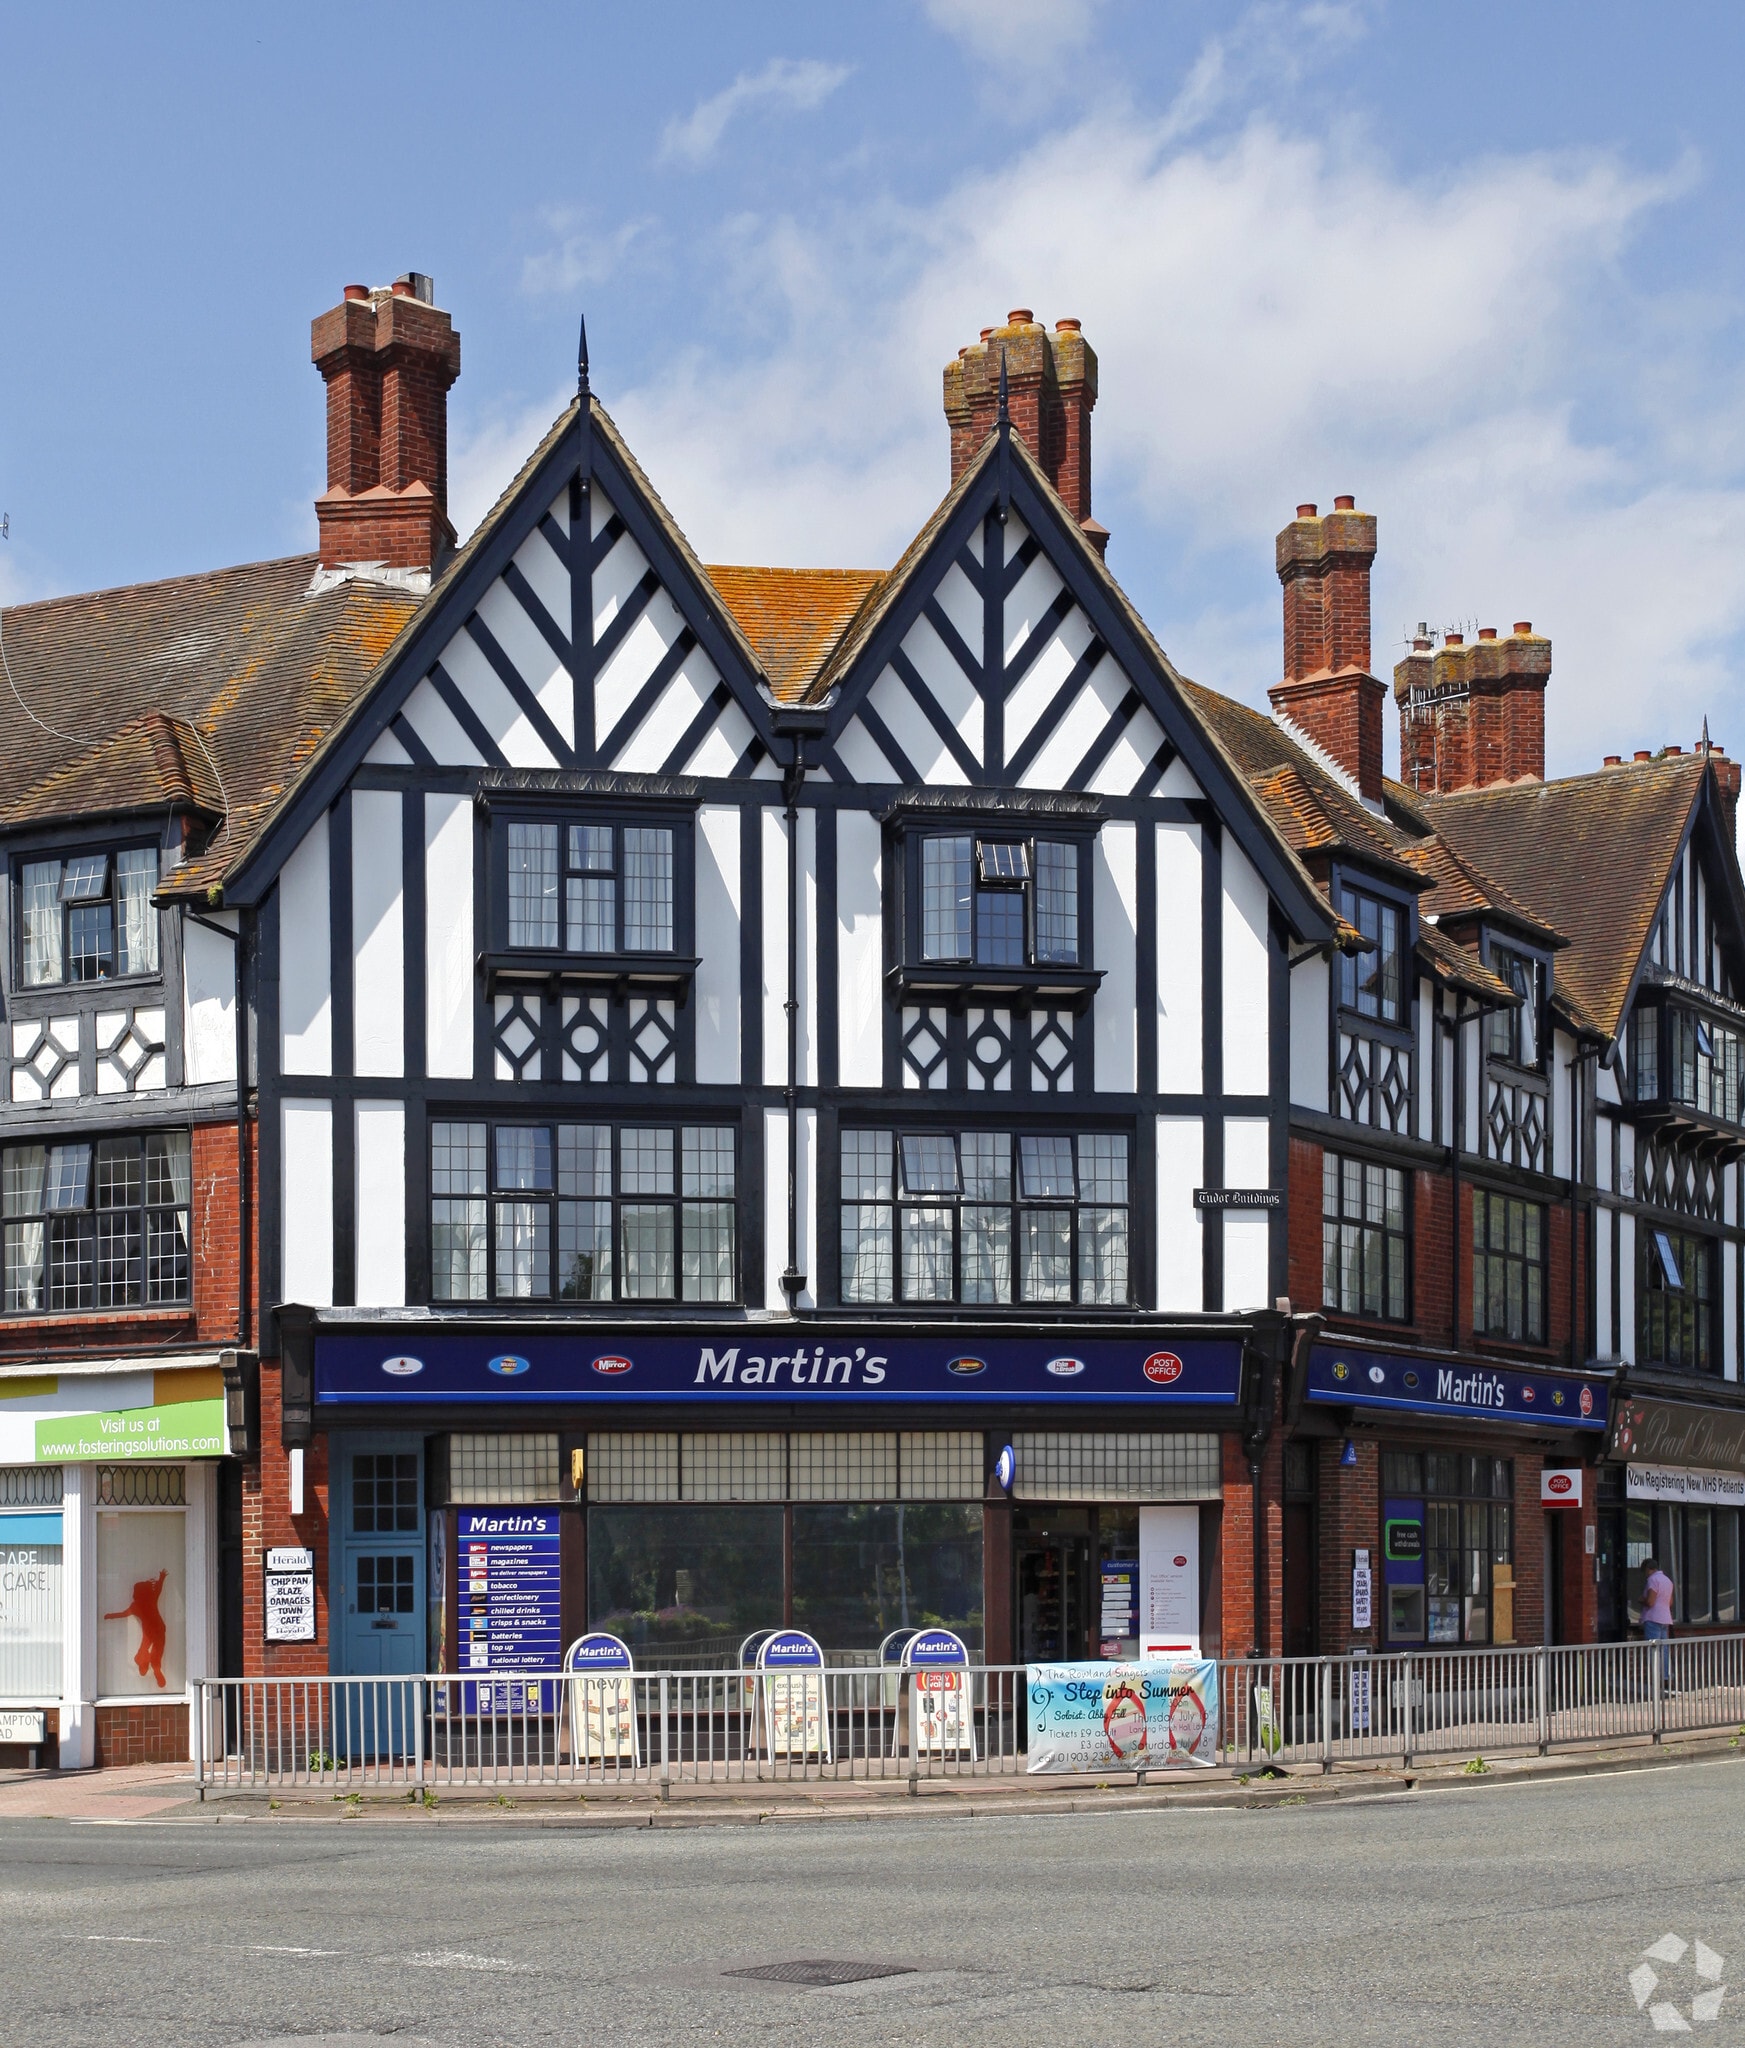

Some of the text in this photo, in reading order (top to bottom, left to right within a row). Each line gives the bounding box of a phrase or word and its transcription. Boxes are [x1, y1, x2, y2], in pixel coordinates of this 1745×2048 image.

[1199, 1191, 1280, 1206] Tudor Buildings
[598, 1360, 627, 1370] Mirror
[693, 1346, 888, 1384] Martin's
[1153, 1359, 1174, 1367] POST
[1147, 1367, 1177, 1376] OFFICE
[1436, 1368, 1505, 1407] Martin's
[100, 1417, 161, 1433] Visit us at
[1643, 1407, 1745, 1462] Pearl Dental
[42, 1436, 221, 1457] www.fosteringsolutions.com
[1627, 1469, 1744, 1494] Now Registering New NHS Patients
[469, 1516, 547, 1532] Martin's
[490, 1544, 533, 1552] newspapers
[0, 1551, 38, 1566] ARE
[272, 1556, 307, 1565] Herald
[490, 1558, 529, 1566] magazines
[271, 1577, 309, 1586] CHIP PAN
[277, 1587, 303, 1596] BLAZE
[270, 1597, 311, 1606] DAMAGES
[490, 1594, 540, 1602] confectionery
[278, 1607, 303, 1615] TOWN
[280, 1616, 301, 1625] CAFE
[578, 1647, 622, 1656] Martin's
[771, 1644, 813, 1653] Martin's
[916, 1642, 958, 1652] Martin's
[521, 1656, 545, 1664] lottery
[929, 1674, 950, 1682] cray
[1046, 1668, 1065, 1679] The
[1067, 1668, 1112, 1679] Rowland
[1064, 1680, 1195, 1707] Step into Summer
[1053, 1709, 1086, 1721] Soloist:
[1133, 1712, 1175, 1723] Thursday
[1179, 1710, 1195, 1722] July
[0, 1715, 41, 1726] MPTON
[1048, 1728, 1117, 1738] Tickets £9 adult
[1080, 1740, 1092, 1750] £3
[1131, 1739, 1176, 1750] Saturda
[1057, 1752, 1089, 1762] 01903
